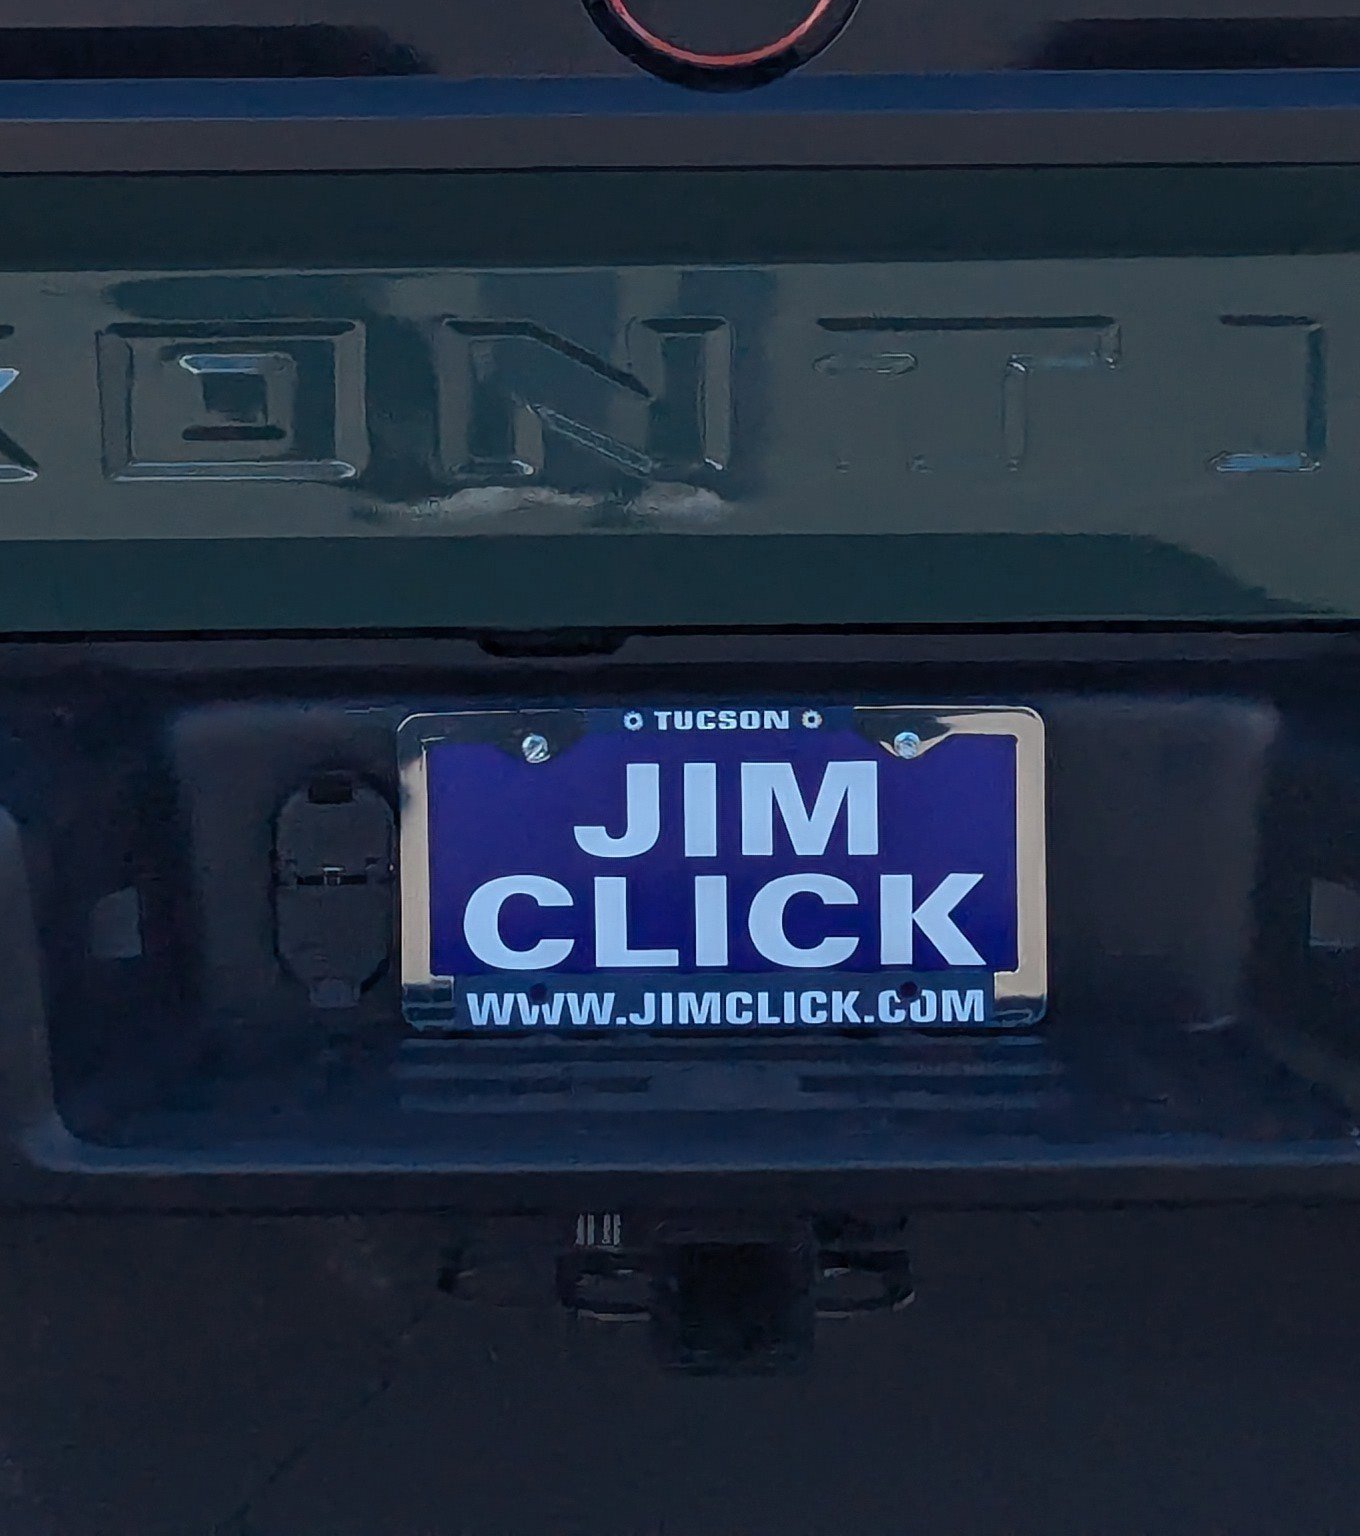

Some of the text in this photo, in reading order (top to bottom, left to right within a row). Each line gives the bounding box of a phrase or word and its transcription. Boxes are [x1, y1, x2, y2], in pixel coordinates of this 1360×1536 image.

[653, 709, 791, 731] TUCSON
[572, 759, 879, 858] JIM
[462, 871, 988, 971] CLICK
[466, 988, 986, 1027] WWW.JIMCLICK.COM
